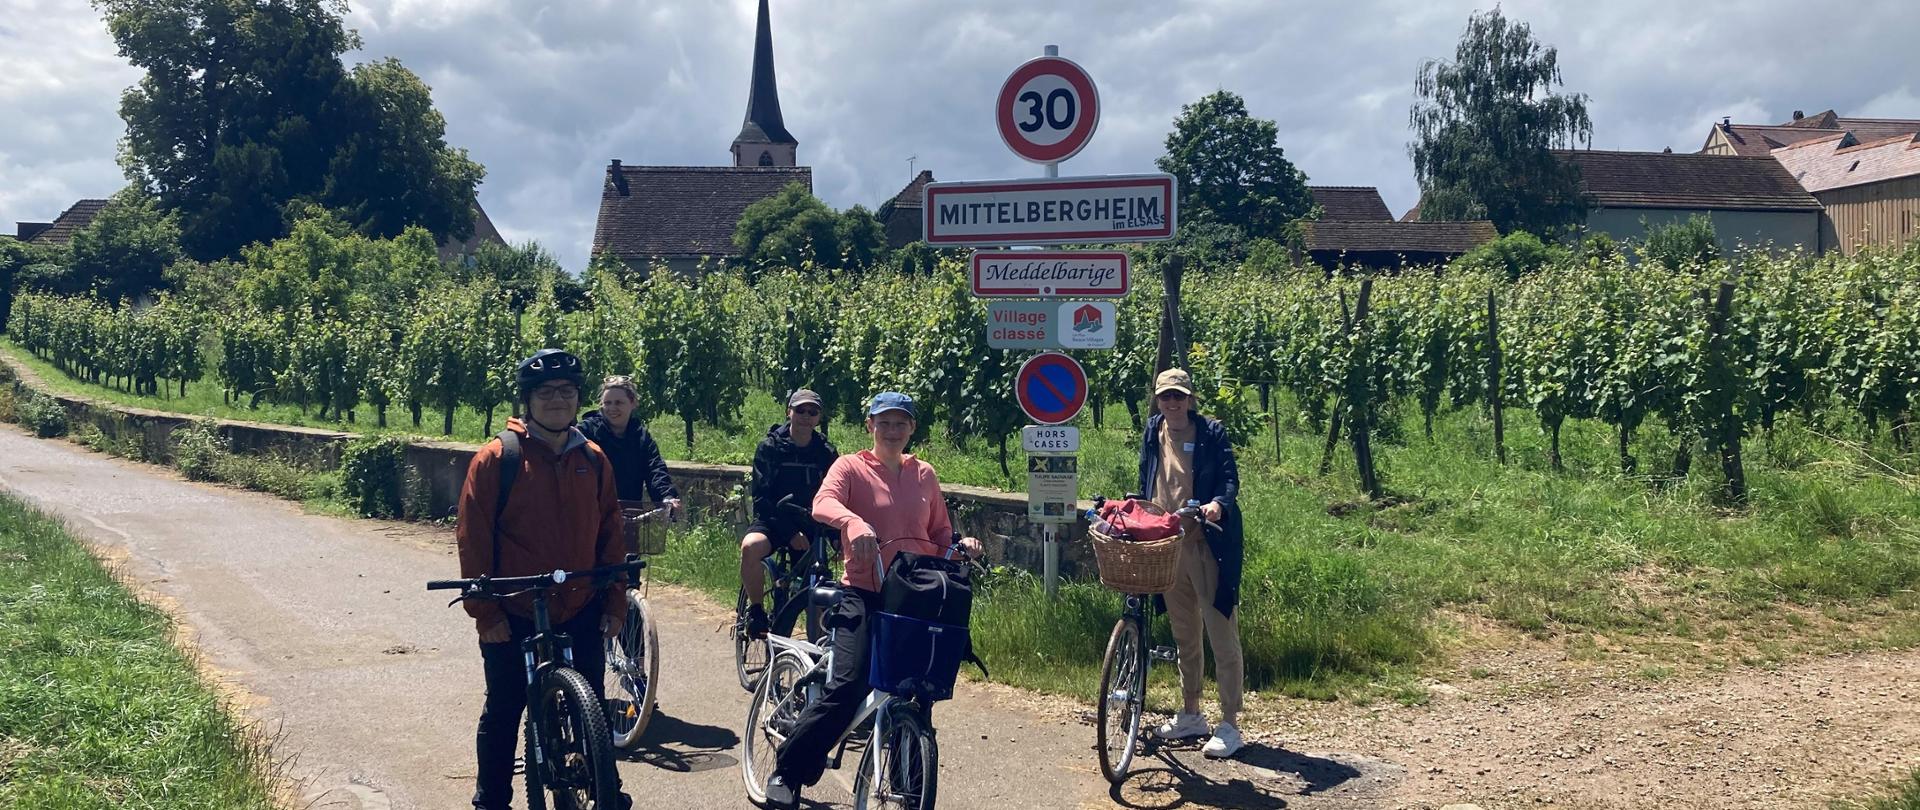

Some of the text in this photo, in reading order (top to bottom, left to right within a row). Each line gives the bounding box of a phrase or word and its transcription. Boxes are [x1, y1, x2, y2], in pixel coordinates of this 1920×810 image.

[1018, 88, 1076, 132] 30
[940, 196, 1158, 225] MITTELBERGHEIM
[1112, 214, 1166, 230] im ELSASS
[986, 263, 1115, 287] Meddelbarige
[992, 310, 1047, 324] Village
[993, 323, 1046, 340] classé
[1036, 430, 1067, 438] HORS
[1034, 440, 1070, 448] CASES
